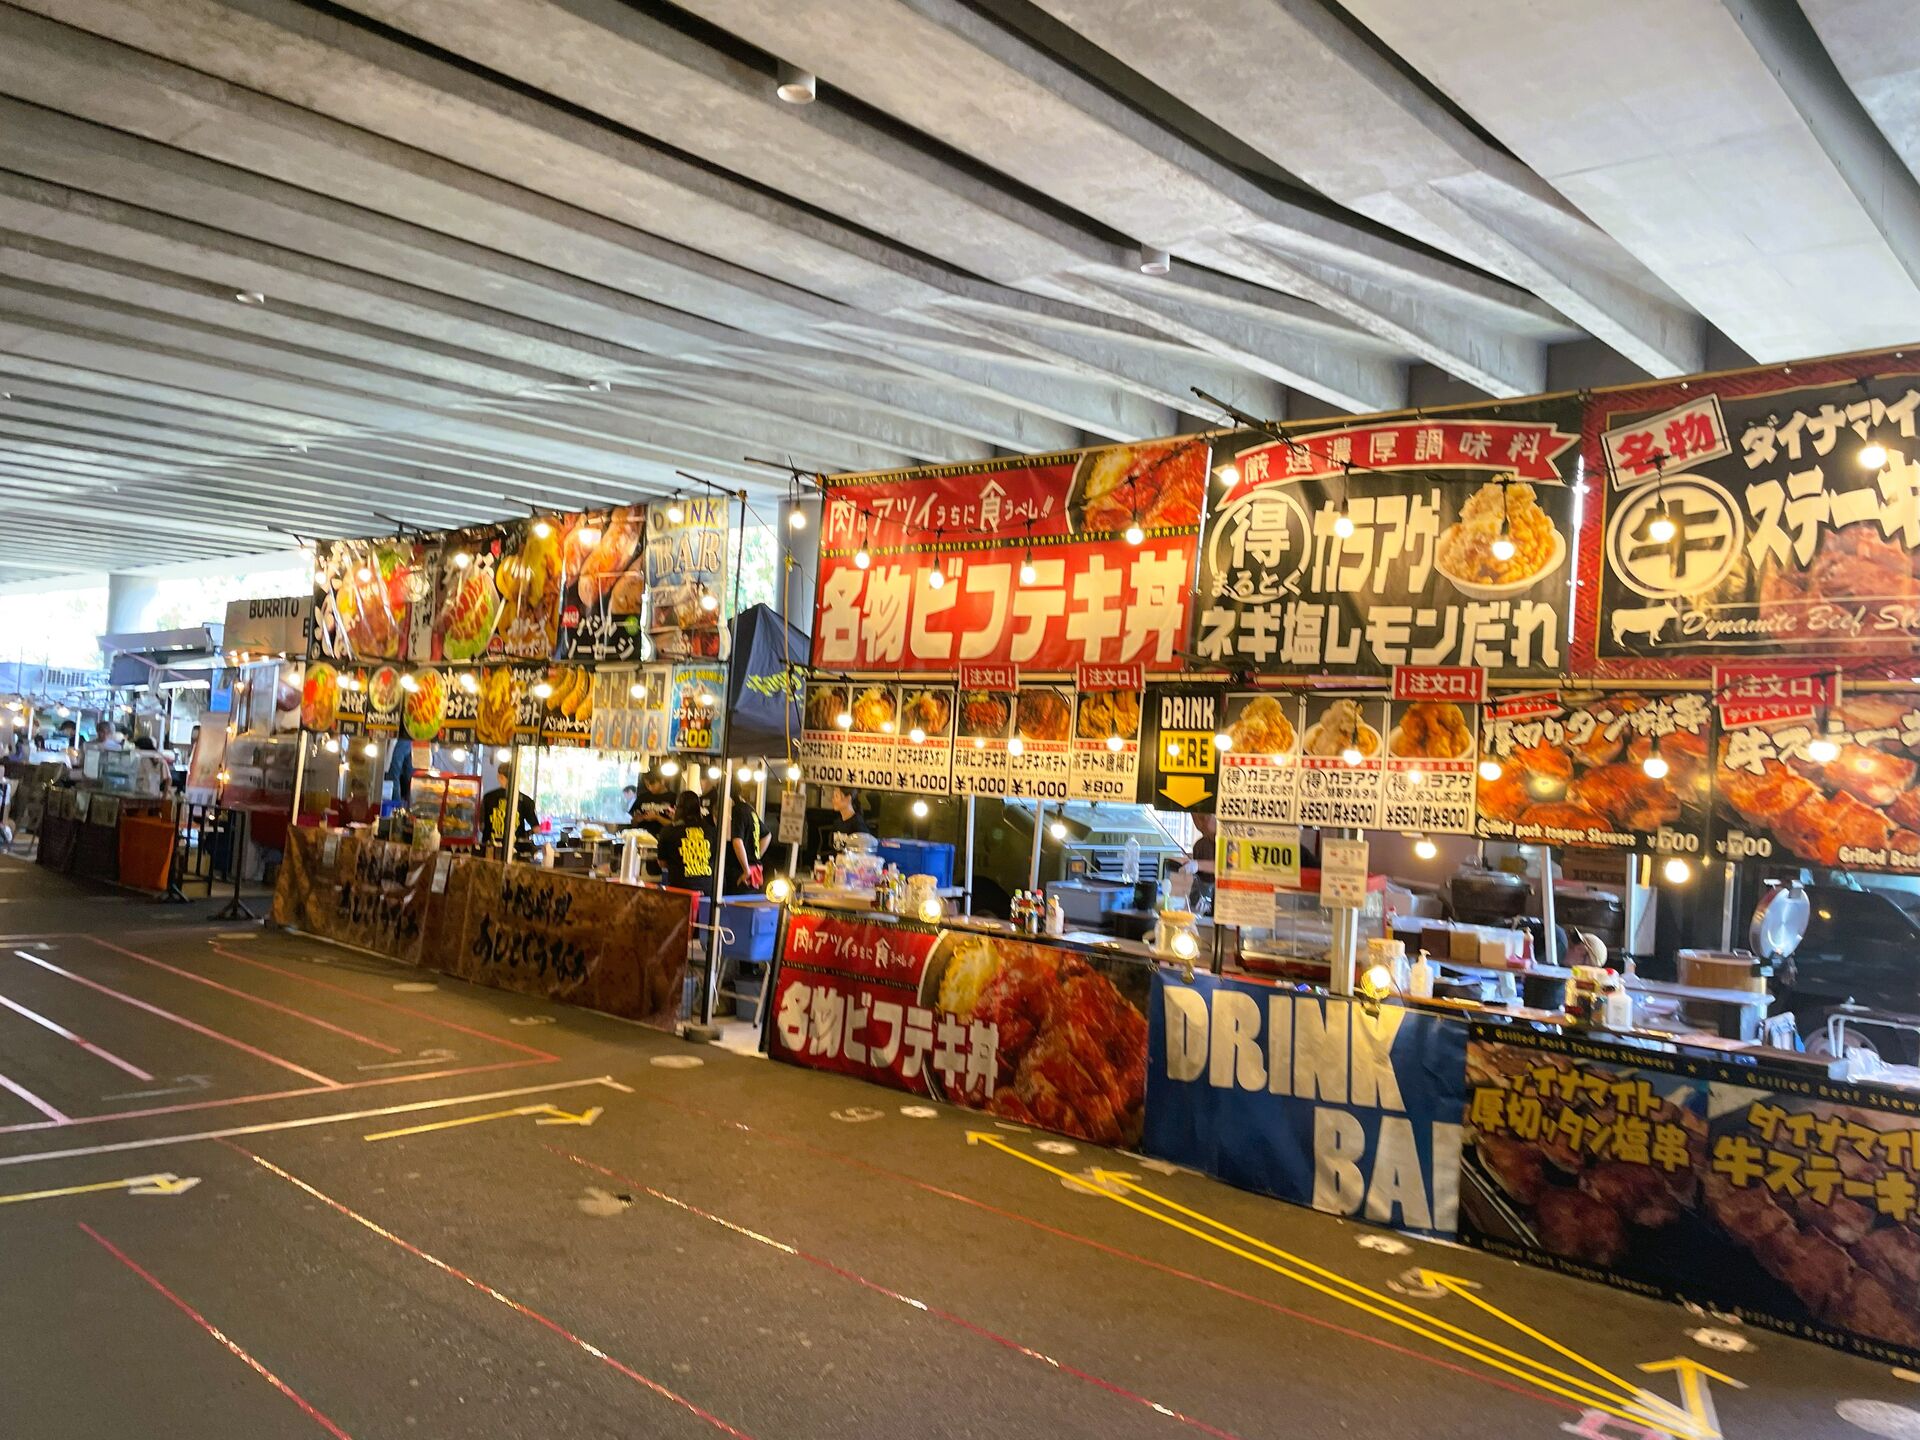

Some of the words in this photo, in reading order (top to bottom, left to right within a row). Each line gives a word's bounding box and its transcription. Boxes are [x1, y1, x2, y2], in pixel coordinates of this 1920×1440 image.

[1616, 412, 1716, 475] 名物
[654, 531, 721, 578] BAR
[1230, 502, 1291, 569] 得
[1311, 487, 1441, 594] カラアゲ
[248, 597, 300, 620] BURRITO
[819, 549, 1189, 664] 名物ビフテキ丼
[1683, 611, 1796, 640] Dynamite
[1807, 604, 1866, 638] Beef
[1195, 599, 1560, 669] ネギ塩レモンだれ
[969, 670, 1007, 686] 注文口
[1088, 668, 1131, 687] 注文口
[1409, 674, 1467, 695] 注文口
[1736, 673, 1812, 698] 注文口
[1161, 695, 1215, 730] DRINK
[1163, 735, 1209, 768] HERE
[1249, 844, 1293, 867] ¥700
[776, 980, 999, 1099] 名物ビフテキ丼
[1162, 984, 1407, 1113] DRINK
[1495, 1028, 1537, 1046] Grilled
[1571, 1042, 1618, 1061] Tongue
[1620, 1050, 1676, 1071] Skewers
[1746, 1071, 1811, 1094] Grilled
[1471, 1087, 1691, 1173] 厚切りタン塩串
